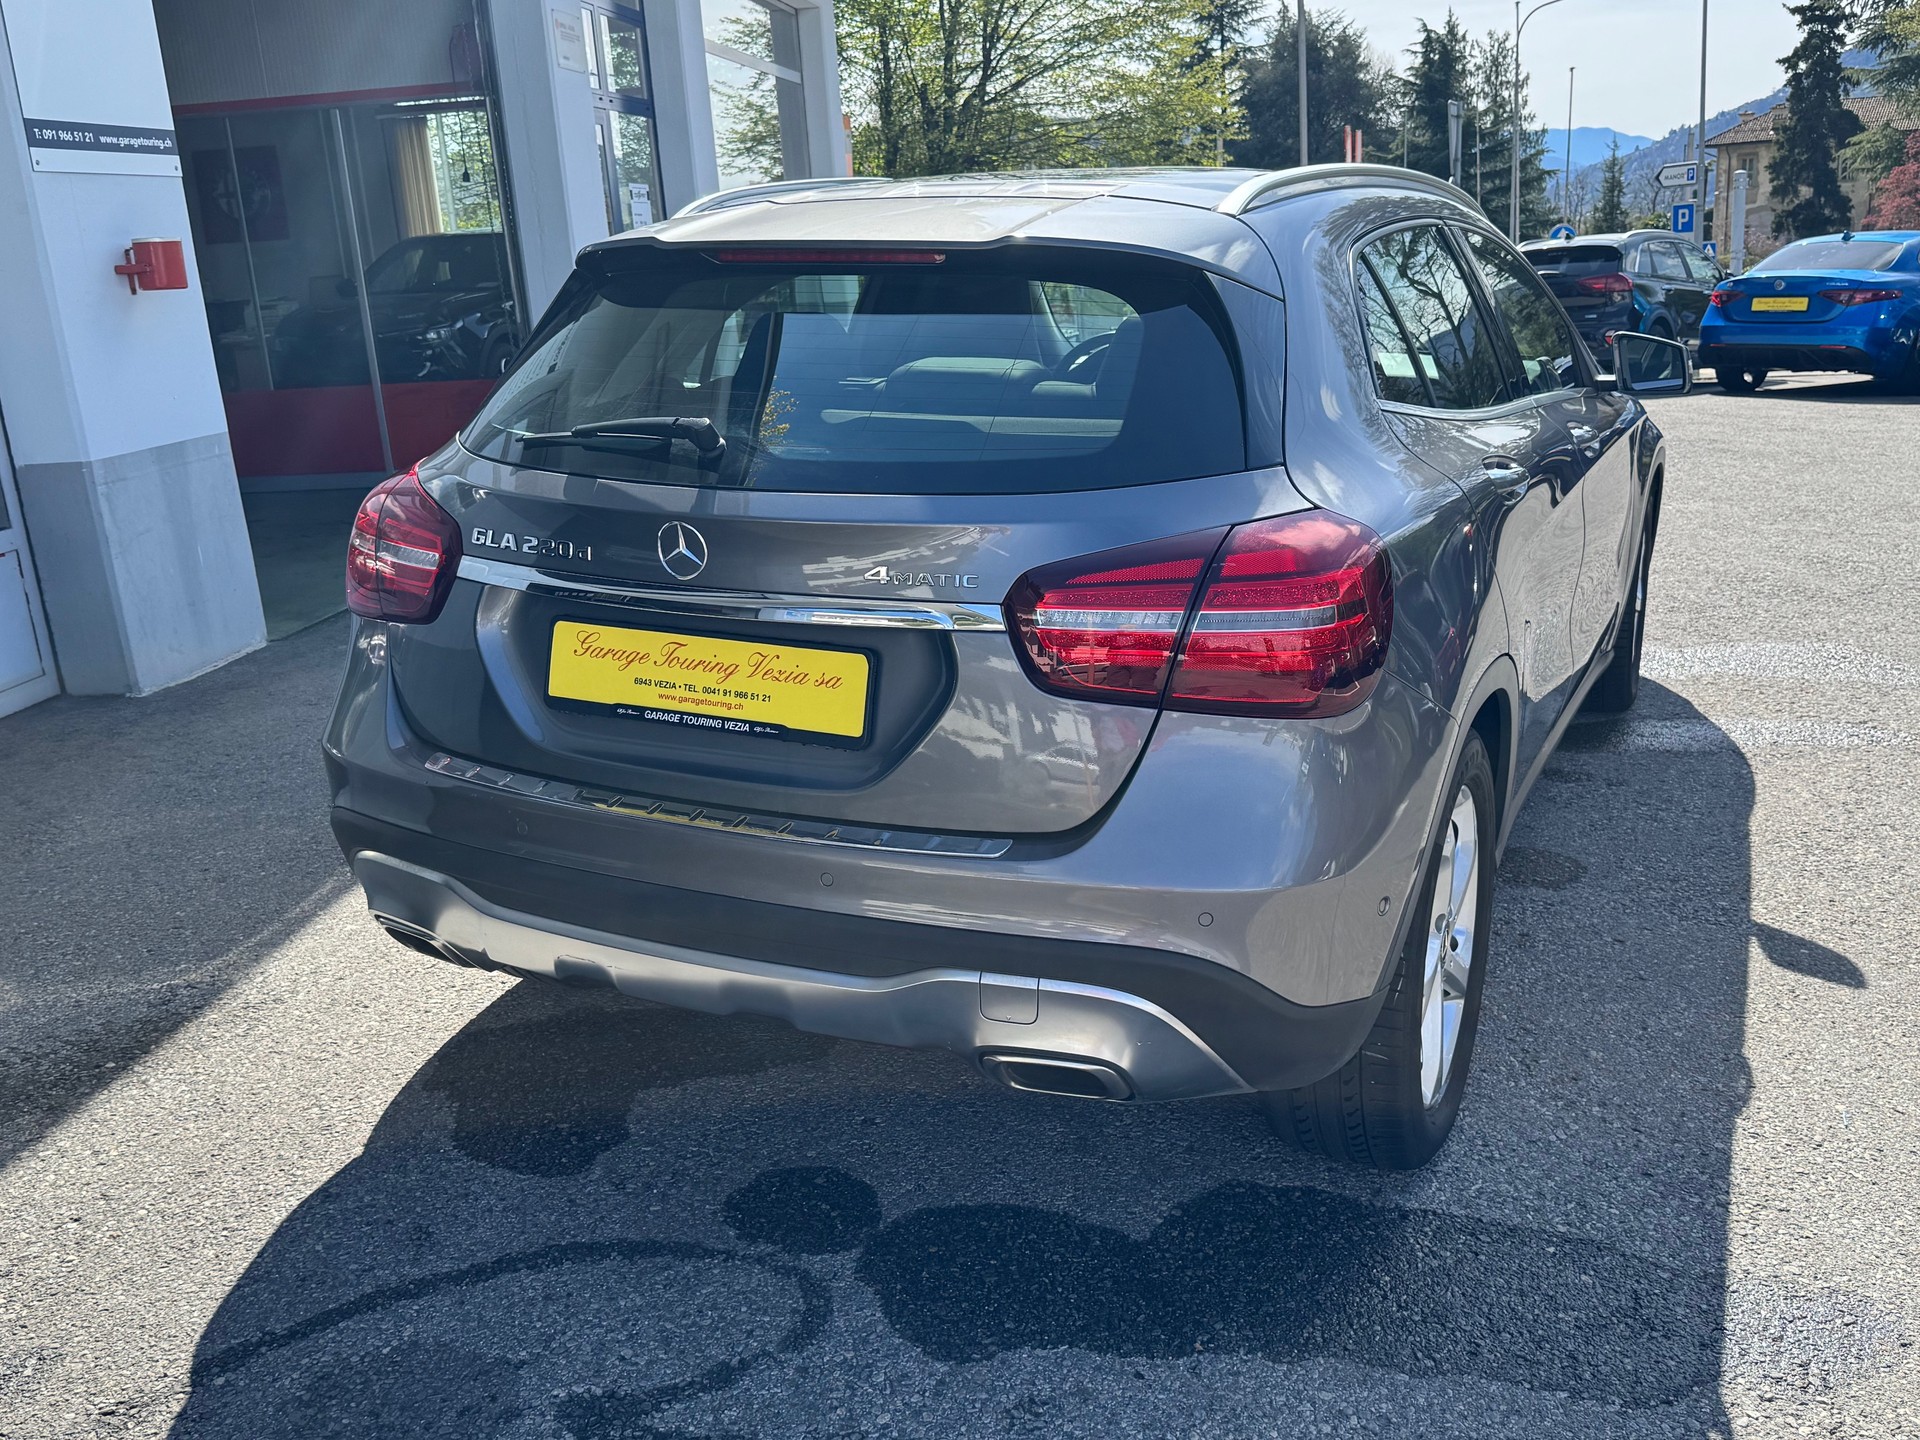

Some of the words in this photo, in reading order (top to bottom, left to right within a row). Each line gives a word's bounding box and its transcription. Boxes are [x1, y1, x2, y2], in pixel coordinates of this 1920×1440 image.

[34, 128, 42, 139] T:
[42, 129, 56, 140] 091
[58, 131, 73, 141] 966
[74, 132, 84, 142] 51
[85, 132, 95, 143] 21
[99, 135, 172, 149] www.garagetouring.ch
[1678, 209, 1689, 230] P
[471, 527, 518, 551] GLA
[864, 565, 979, 588] 4MATIC
[573, 630, 651, 671] Garage
[653, 641, 740, 685] Touring
[746, 651, 811, 685] Vezia
[813, 672, 843, 690] sa
[634, 677, 653, 687] 6943
[653, 680, 677, 690] VEZIA
[683, 684, 700, 694] TEL.
[701, 686, 721, 697] 0041
[722, 689, 733, 698] 91
[733, 691, 749, 700] 966
[750, 693, 760, 701] 51
[761, 694, 772, 703] 21
[658, 692, 744, 710] www.garagetouring.ch
[644, 710, 681, 723] GARAGE
[682, 715, 723, 730] TOURING
[724, 721, 750, 733] VEZIA
